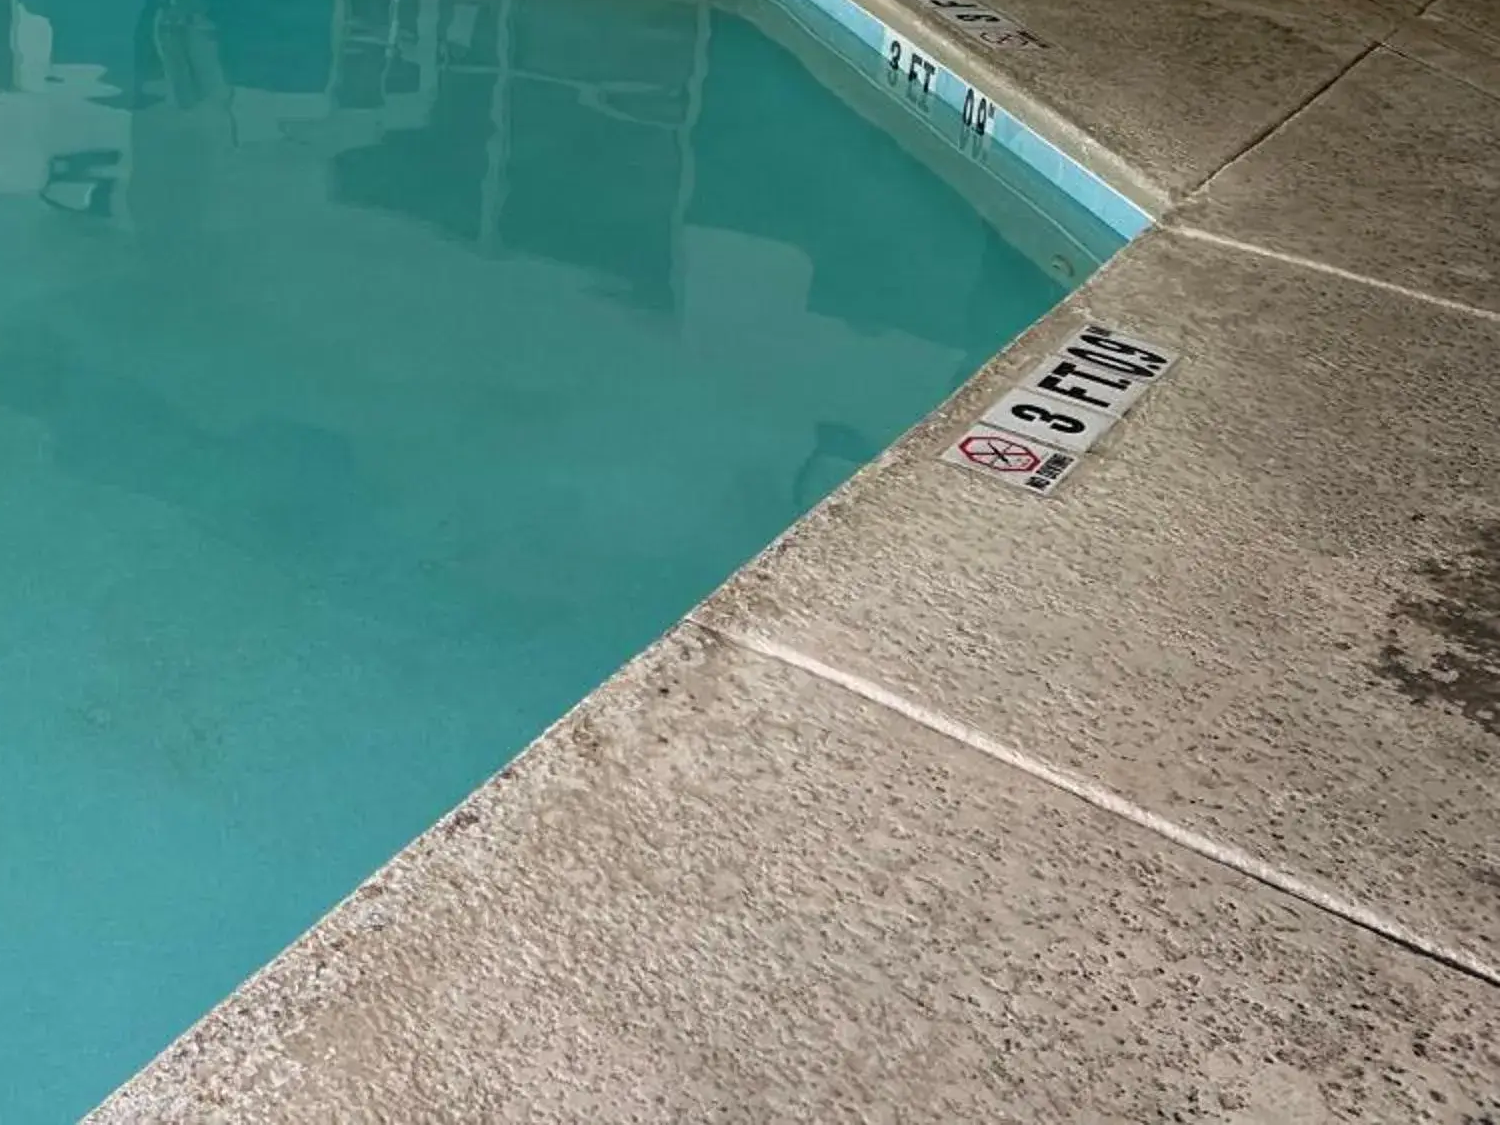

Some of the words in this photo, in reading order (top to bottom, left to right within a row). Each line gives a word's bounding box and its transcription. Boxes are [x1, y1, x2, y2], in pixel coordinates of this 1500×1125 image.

[888, 40, 901, 70] 3
[908, 53, 936, 93] FT
[1011, 404, 1086, 434] 3
[1025, 477, 1050, 491] NO
